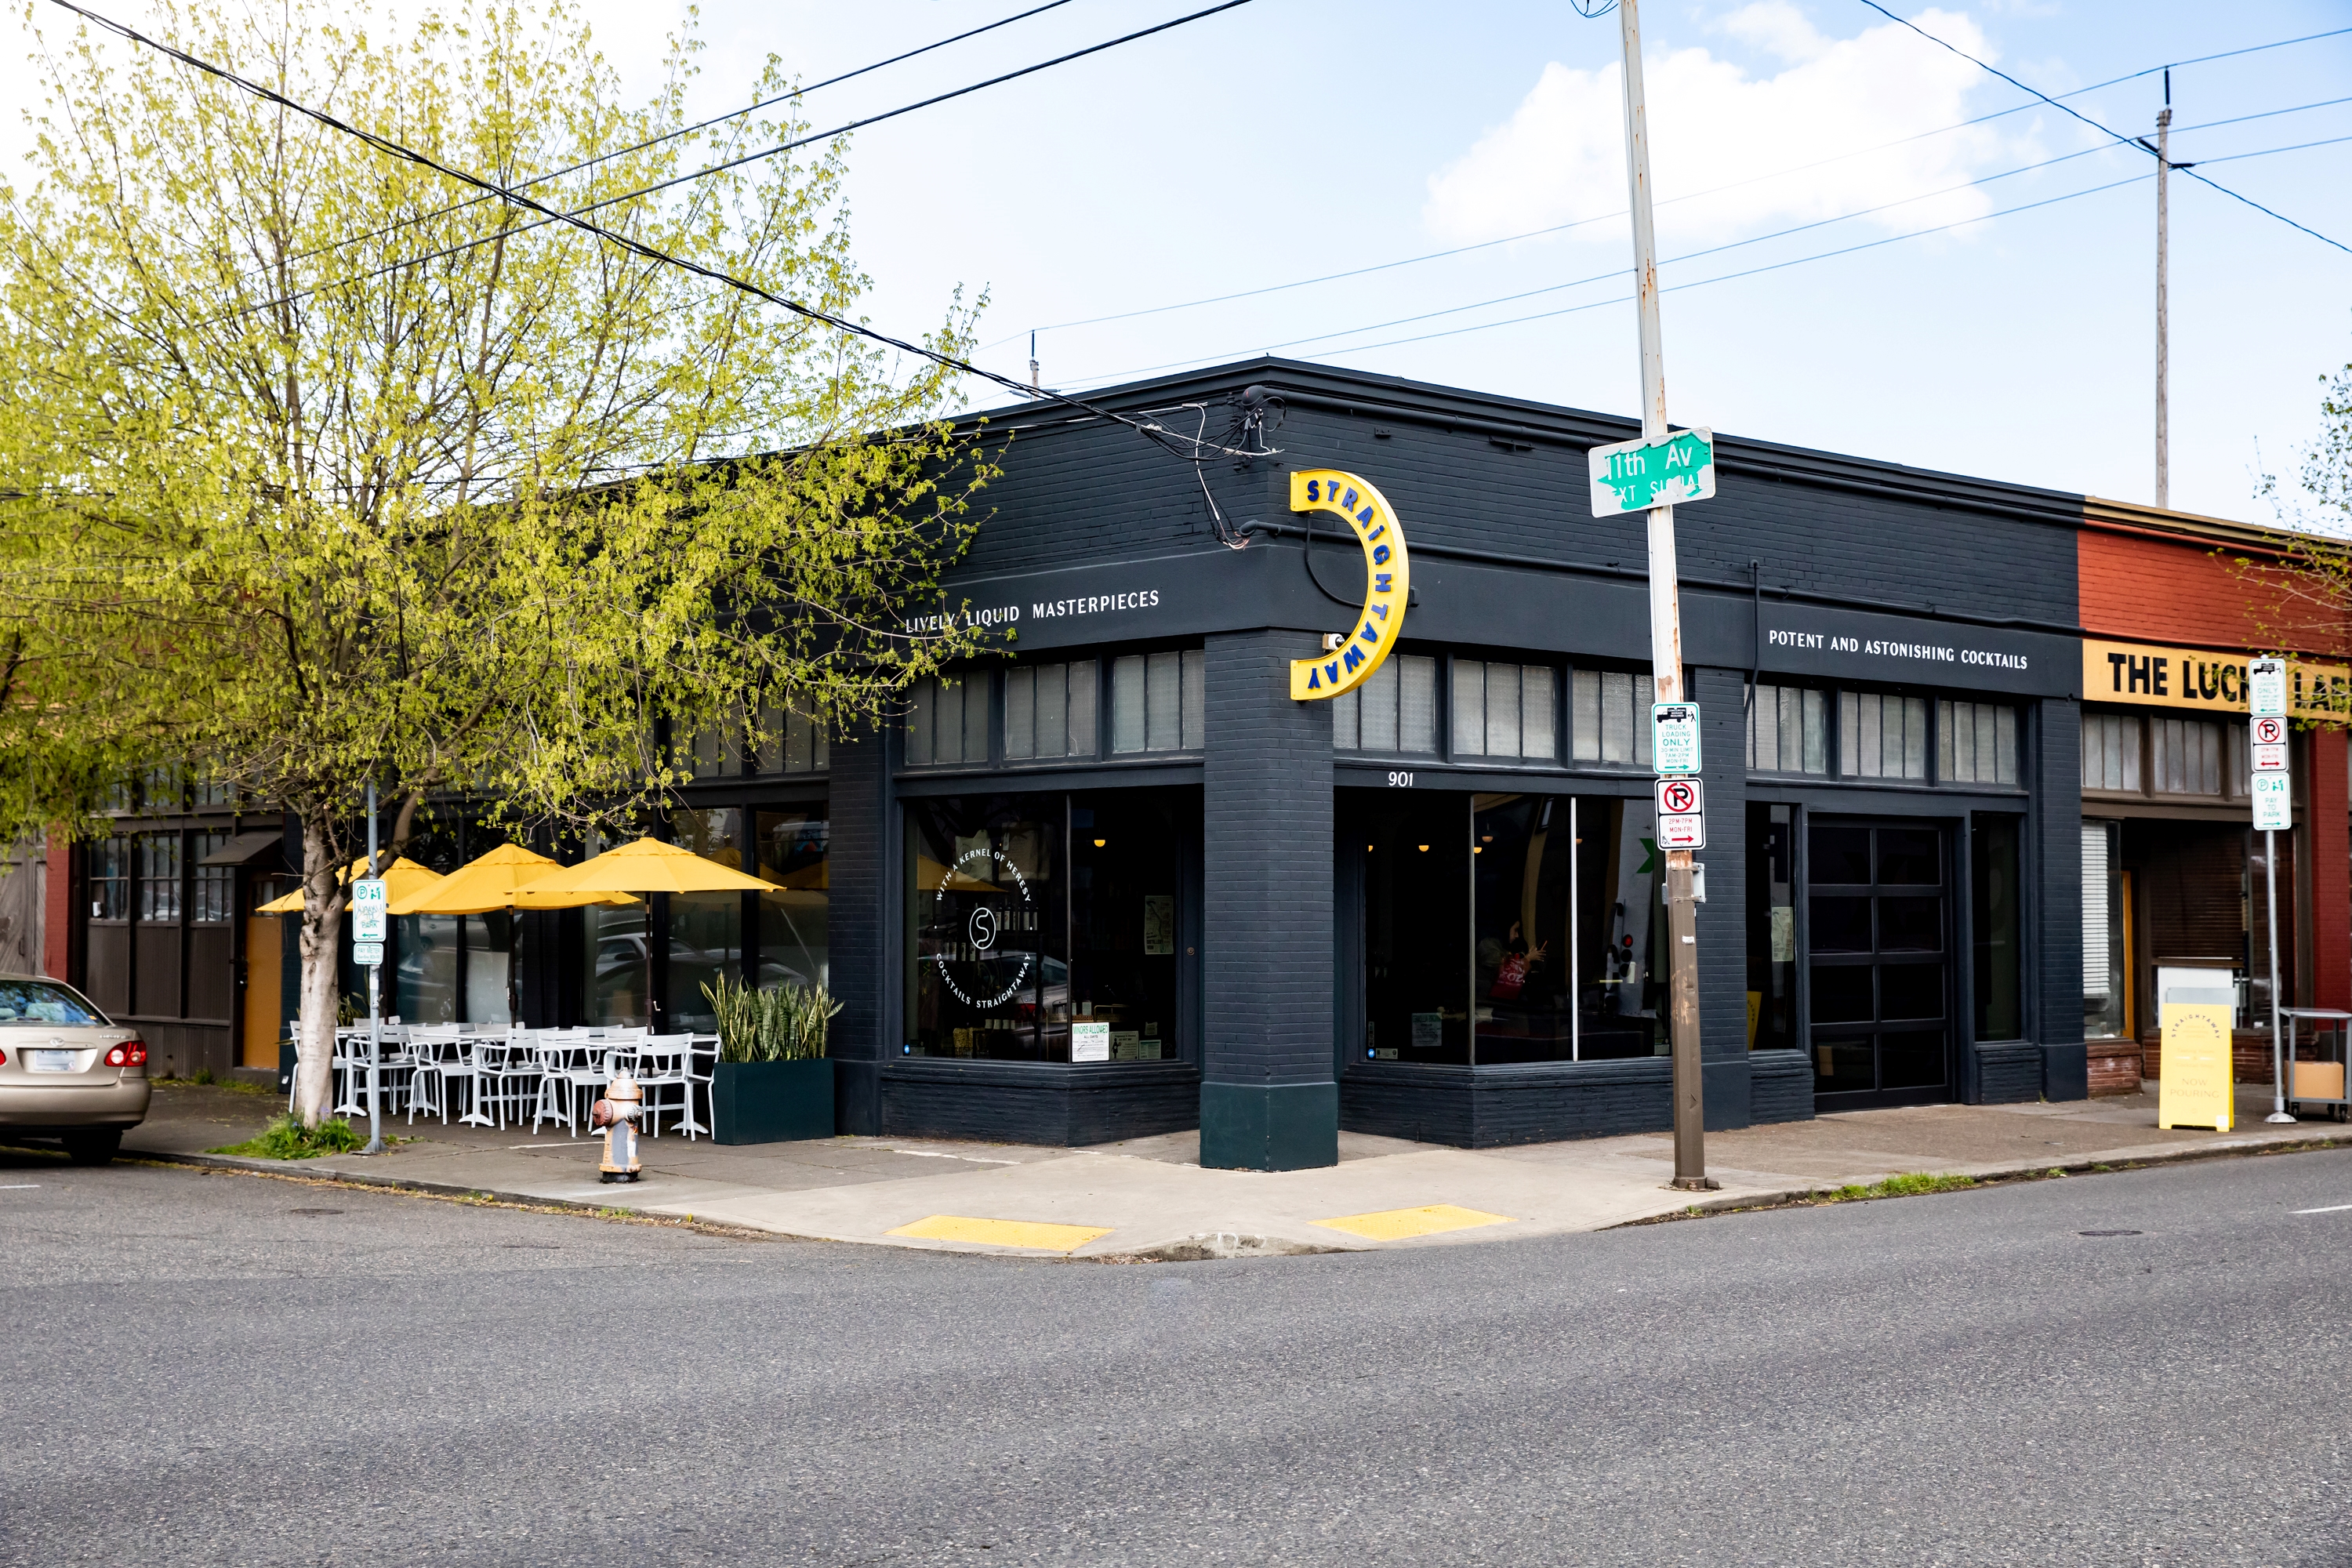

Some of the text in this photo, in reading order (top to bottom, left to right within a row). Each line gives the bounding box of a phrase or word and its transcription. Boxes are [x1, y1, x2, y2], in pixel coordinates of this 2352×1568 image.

[1606, 444, 1692, 480] 11th Av
[906, 590, 1160, 633] LIVELY LIQUID MASTERPIECES
[1769, 630, 2027, 670] POTENT AND ASTONISHING COCKTAILS
[2107, 652, 2168, 696] THE
[1388, 771, 1414, 787] 901
[936, 848, 1031, 902] WITH A KERNEL OF HERESY
[936, 953, 1031, 1008] COCKTAILS STRAIGHTAWAY
[1073, 1025, 1109, 1035] MINORS ALLOWED
[2170, 1088, 2220, 1098] POURING
